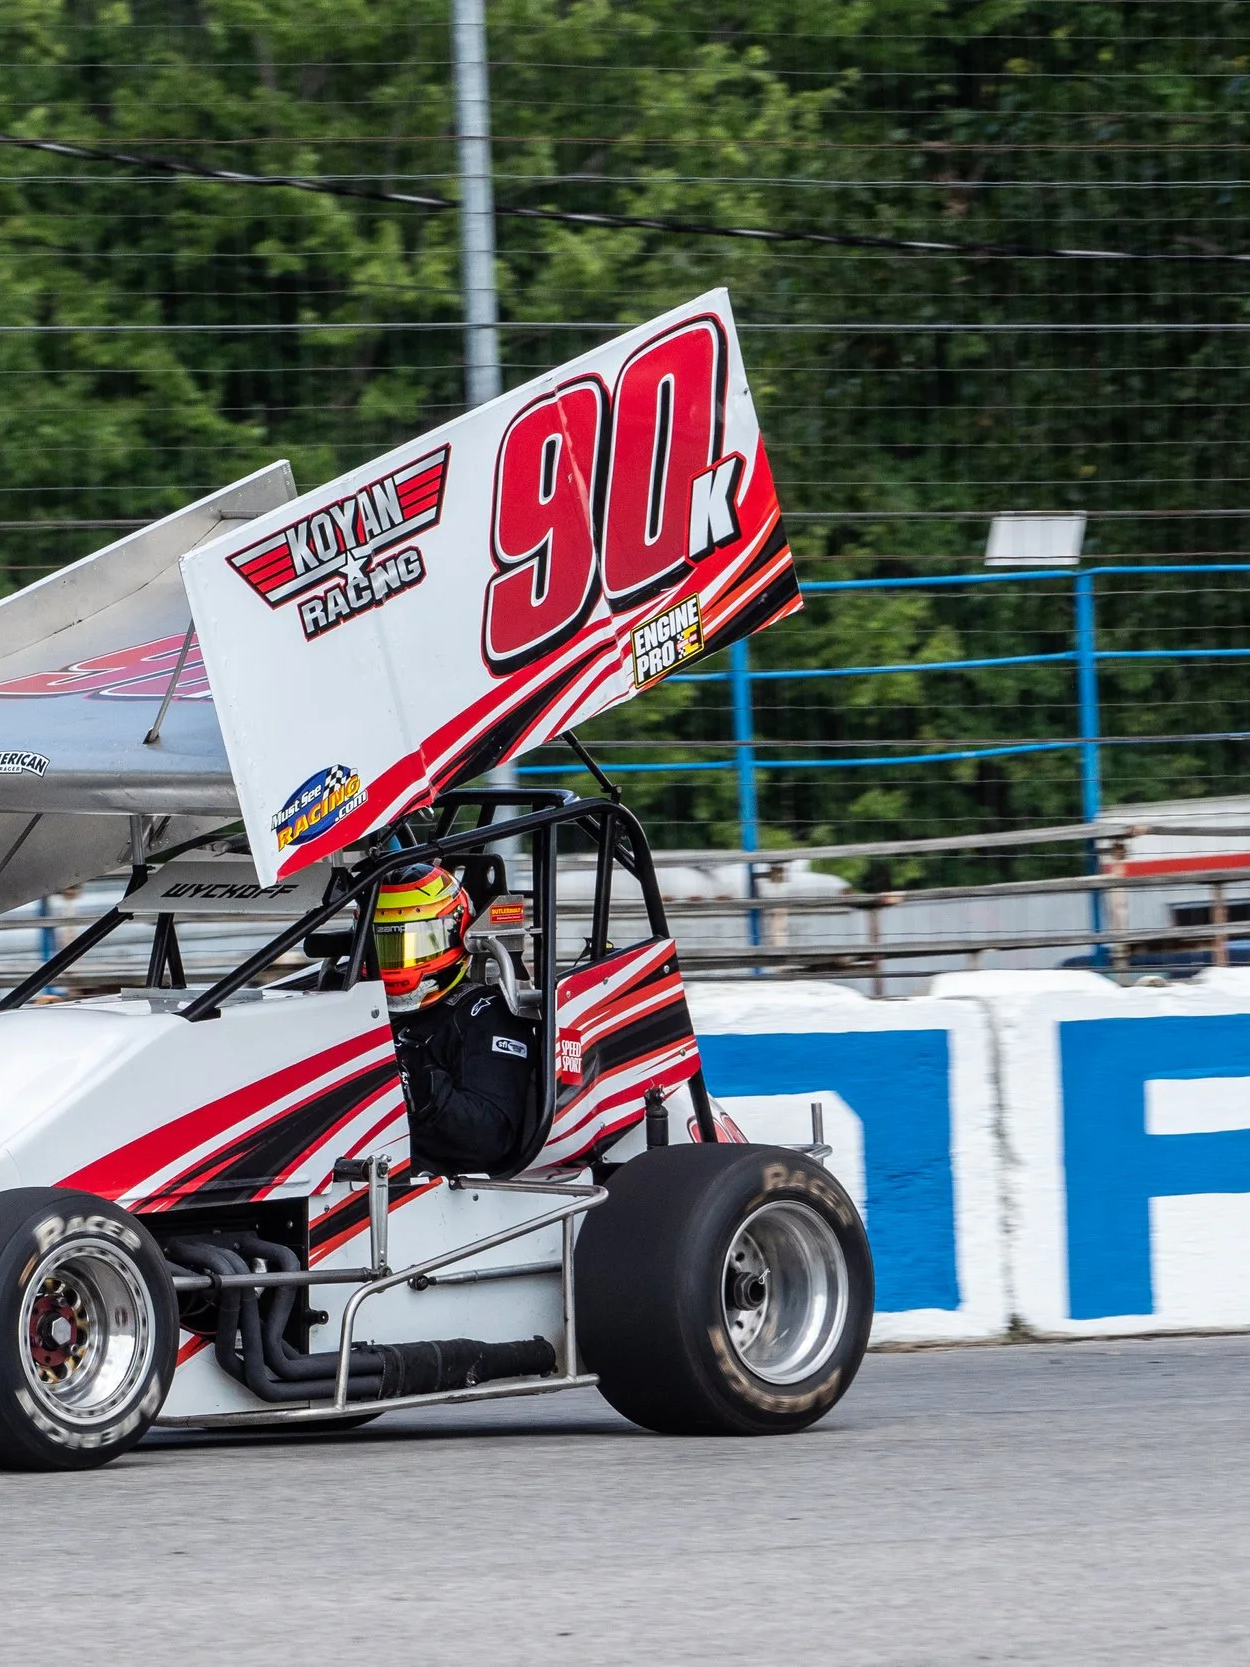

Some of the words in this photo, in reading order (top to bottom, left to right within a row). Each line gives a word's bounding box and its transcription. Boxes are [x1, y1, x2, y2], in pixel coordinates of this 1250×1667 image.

[483, 314, 728, 678] 90
[284, 477, 404, 577] KOYAN
[634, 597, 699, 658] ENGINE
[637, 640, 676, 683] PRO
[271, 799, 301, 831] Must
[301, 784, 322, 808] See
[277, 774, 360, 852] RACING
[334, 789, 367, 822] .com
[160, 883, 300, 899] WYCKOFF
[561, 1040, 582, 1057] SPEED
[562, 1056, 583, 1073] SPORT
